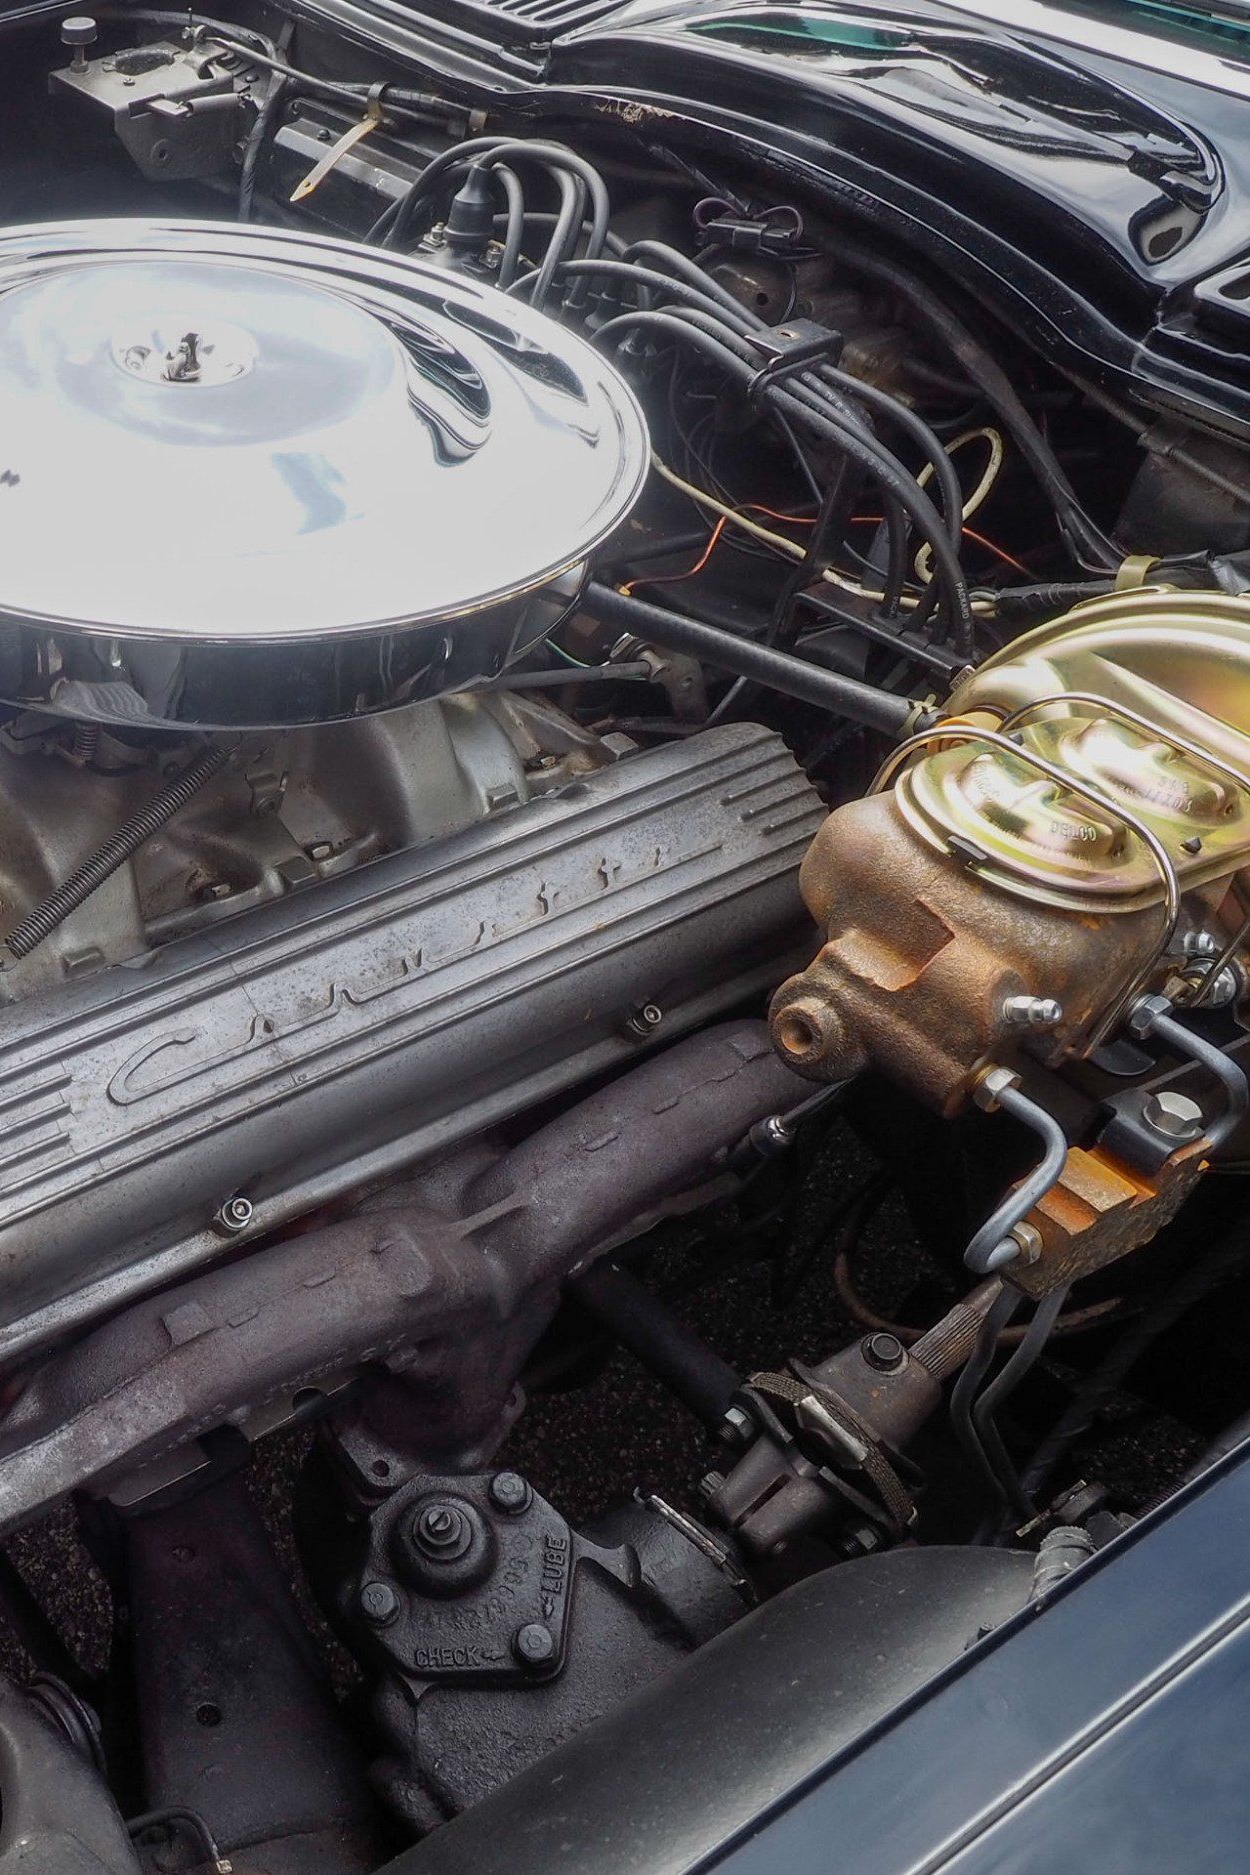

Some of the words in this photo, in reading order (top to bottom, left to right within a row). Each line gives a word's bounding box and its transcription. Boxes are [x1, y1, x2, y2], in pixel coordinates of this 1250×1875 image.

[956, 582, 969, 619] PACKARD
[542, 1534, 567, 1594] LUBE
[414, 1646, 482, 1668] CHECK
